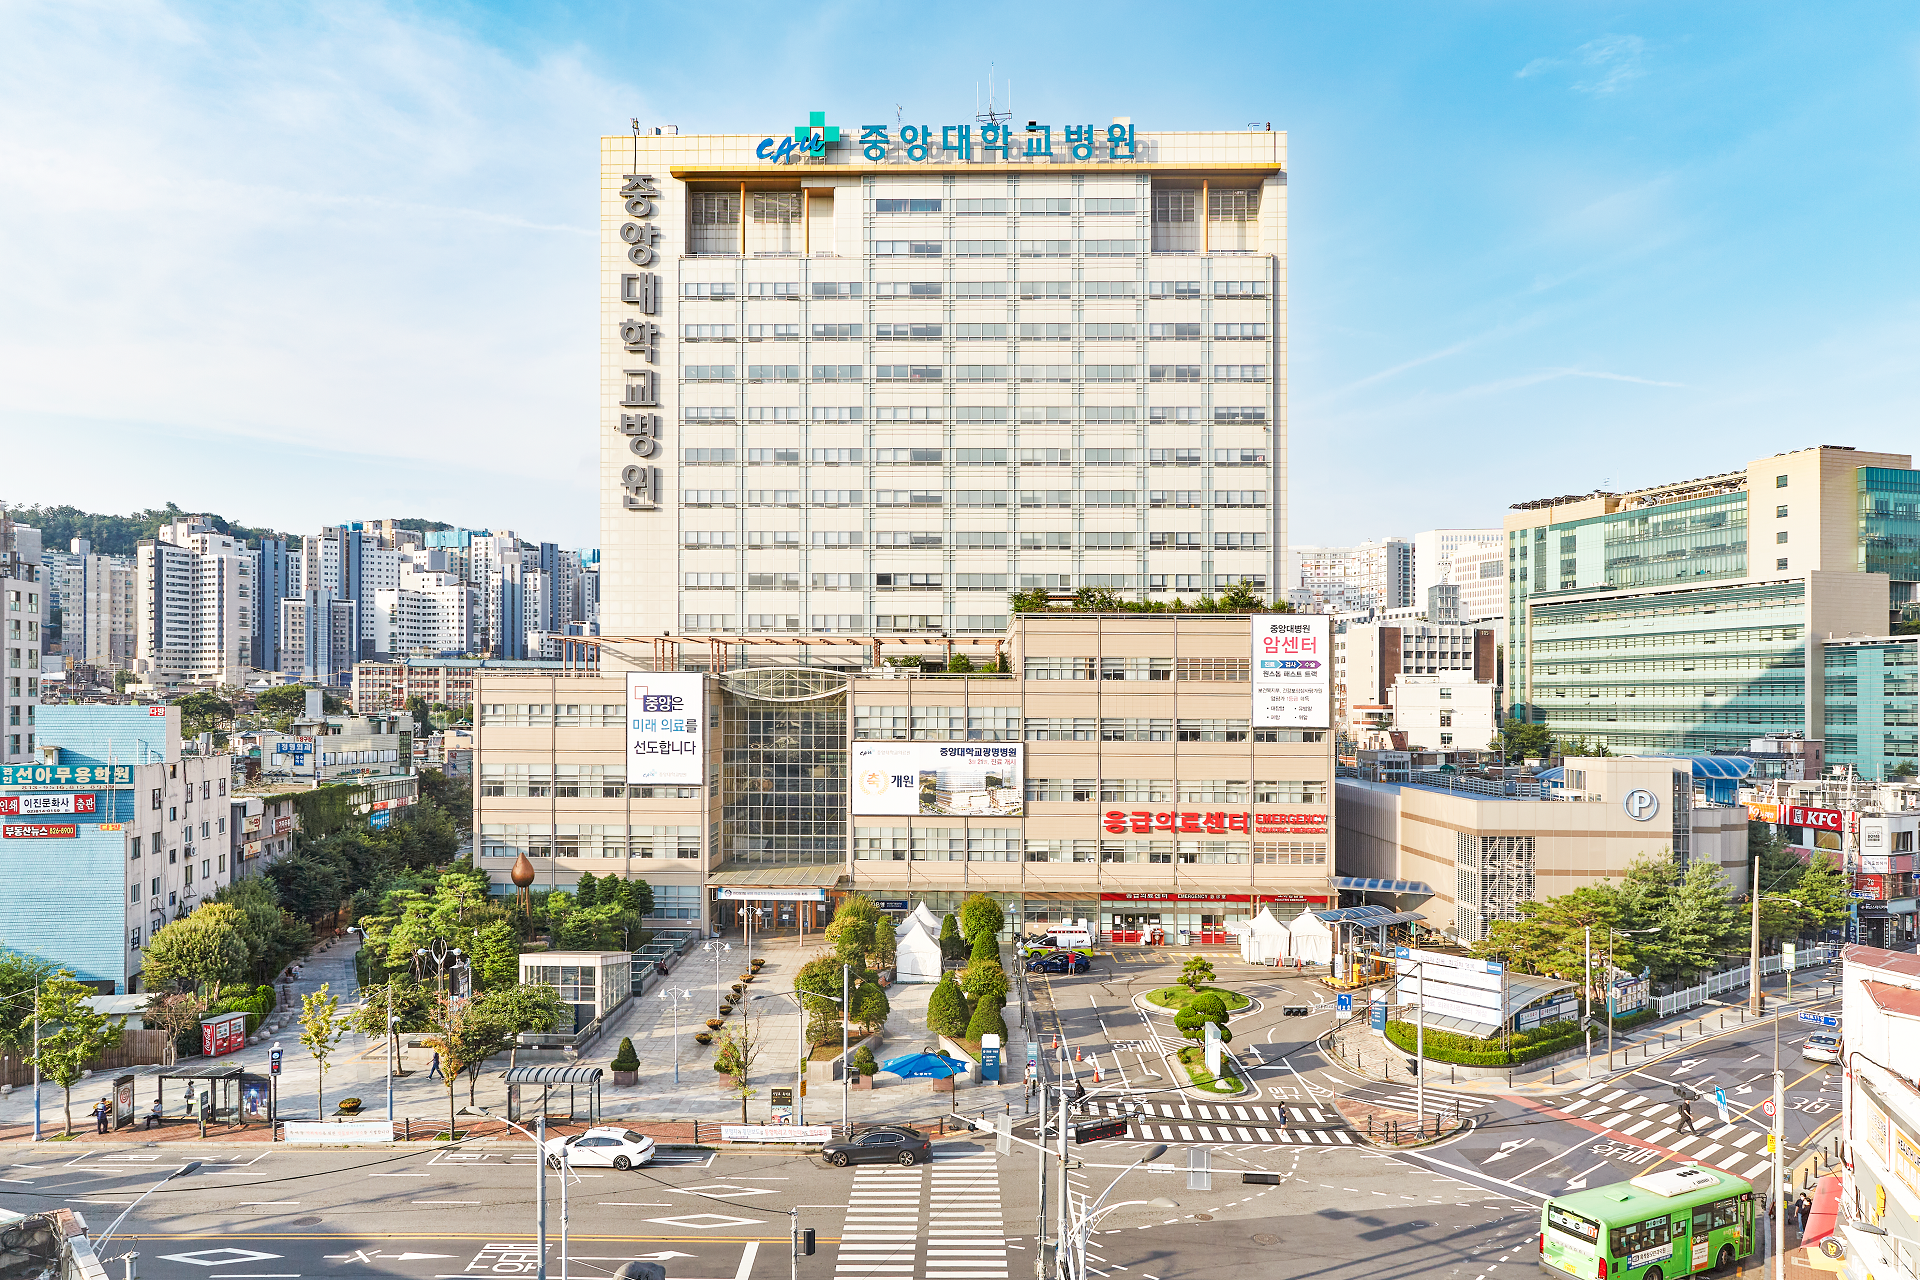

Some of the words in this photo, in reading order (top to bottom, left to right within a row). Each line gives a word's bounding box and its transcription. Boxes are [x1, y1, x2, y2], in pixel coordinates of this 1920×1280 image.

[858, 123, 1135, 162] 중앙대학교병원
[619, 174, 659, 510] 중앙대학교병원
[1270, 624, 1310, 633] 중앙대병원
[1263, 636, 1317, 654] 암센터
[645, 696, 684, 711] 중앙은
[150, 707, 165, 716] 다방
[633, 719, 656, 732] 미래
[661, 719, 698, 733] 의료를
[634, 741, 696, 755] 선도합니다
[939, 747, 1017, 757] 중앙대학교광명병원
[16, 767, 130, 784] 선아무용학원
[867, 773, 880, 788] 축
[891, 775, 914, 788] 개원
[0, 799, 18, 813] 인쇄
[24, 797, 69, 808] 이진문화사
[1633, 792, 1650, 817] P
[1104, 810, 1249, 834] 응급의료센터
[1255, 814, 1327, 824] EMERGENCY
[1806, 811, 1838, 827] KFC
[5, 826, 48, 836] 부동산뉴스
[1267, 1086, 1303, 1100] 입구
[1764, 1104, 1773, 1114] 30
[1589, 1228, 1598, 1239] 01
